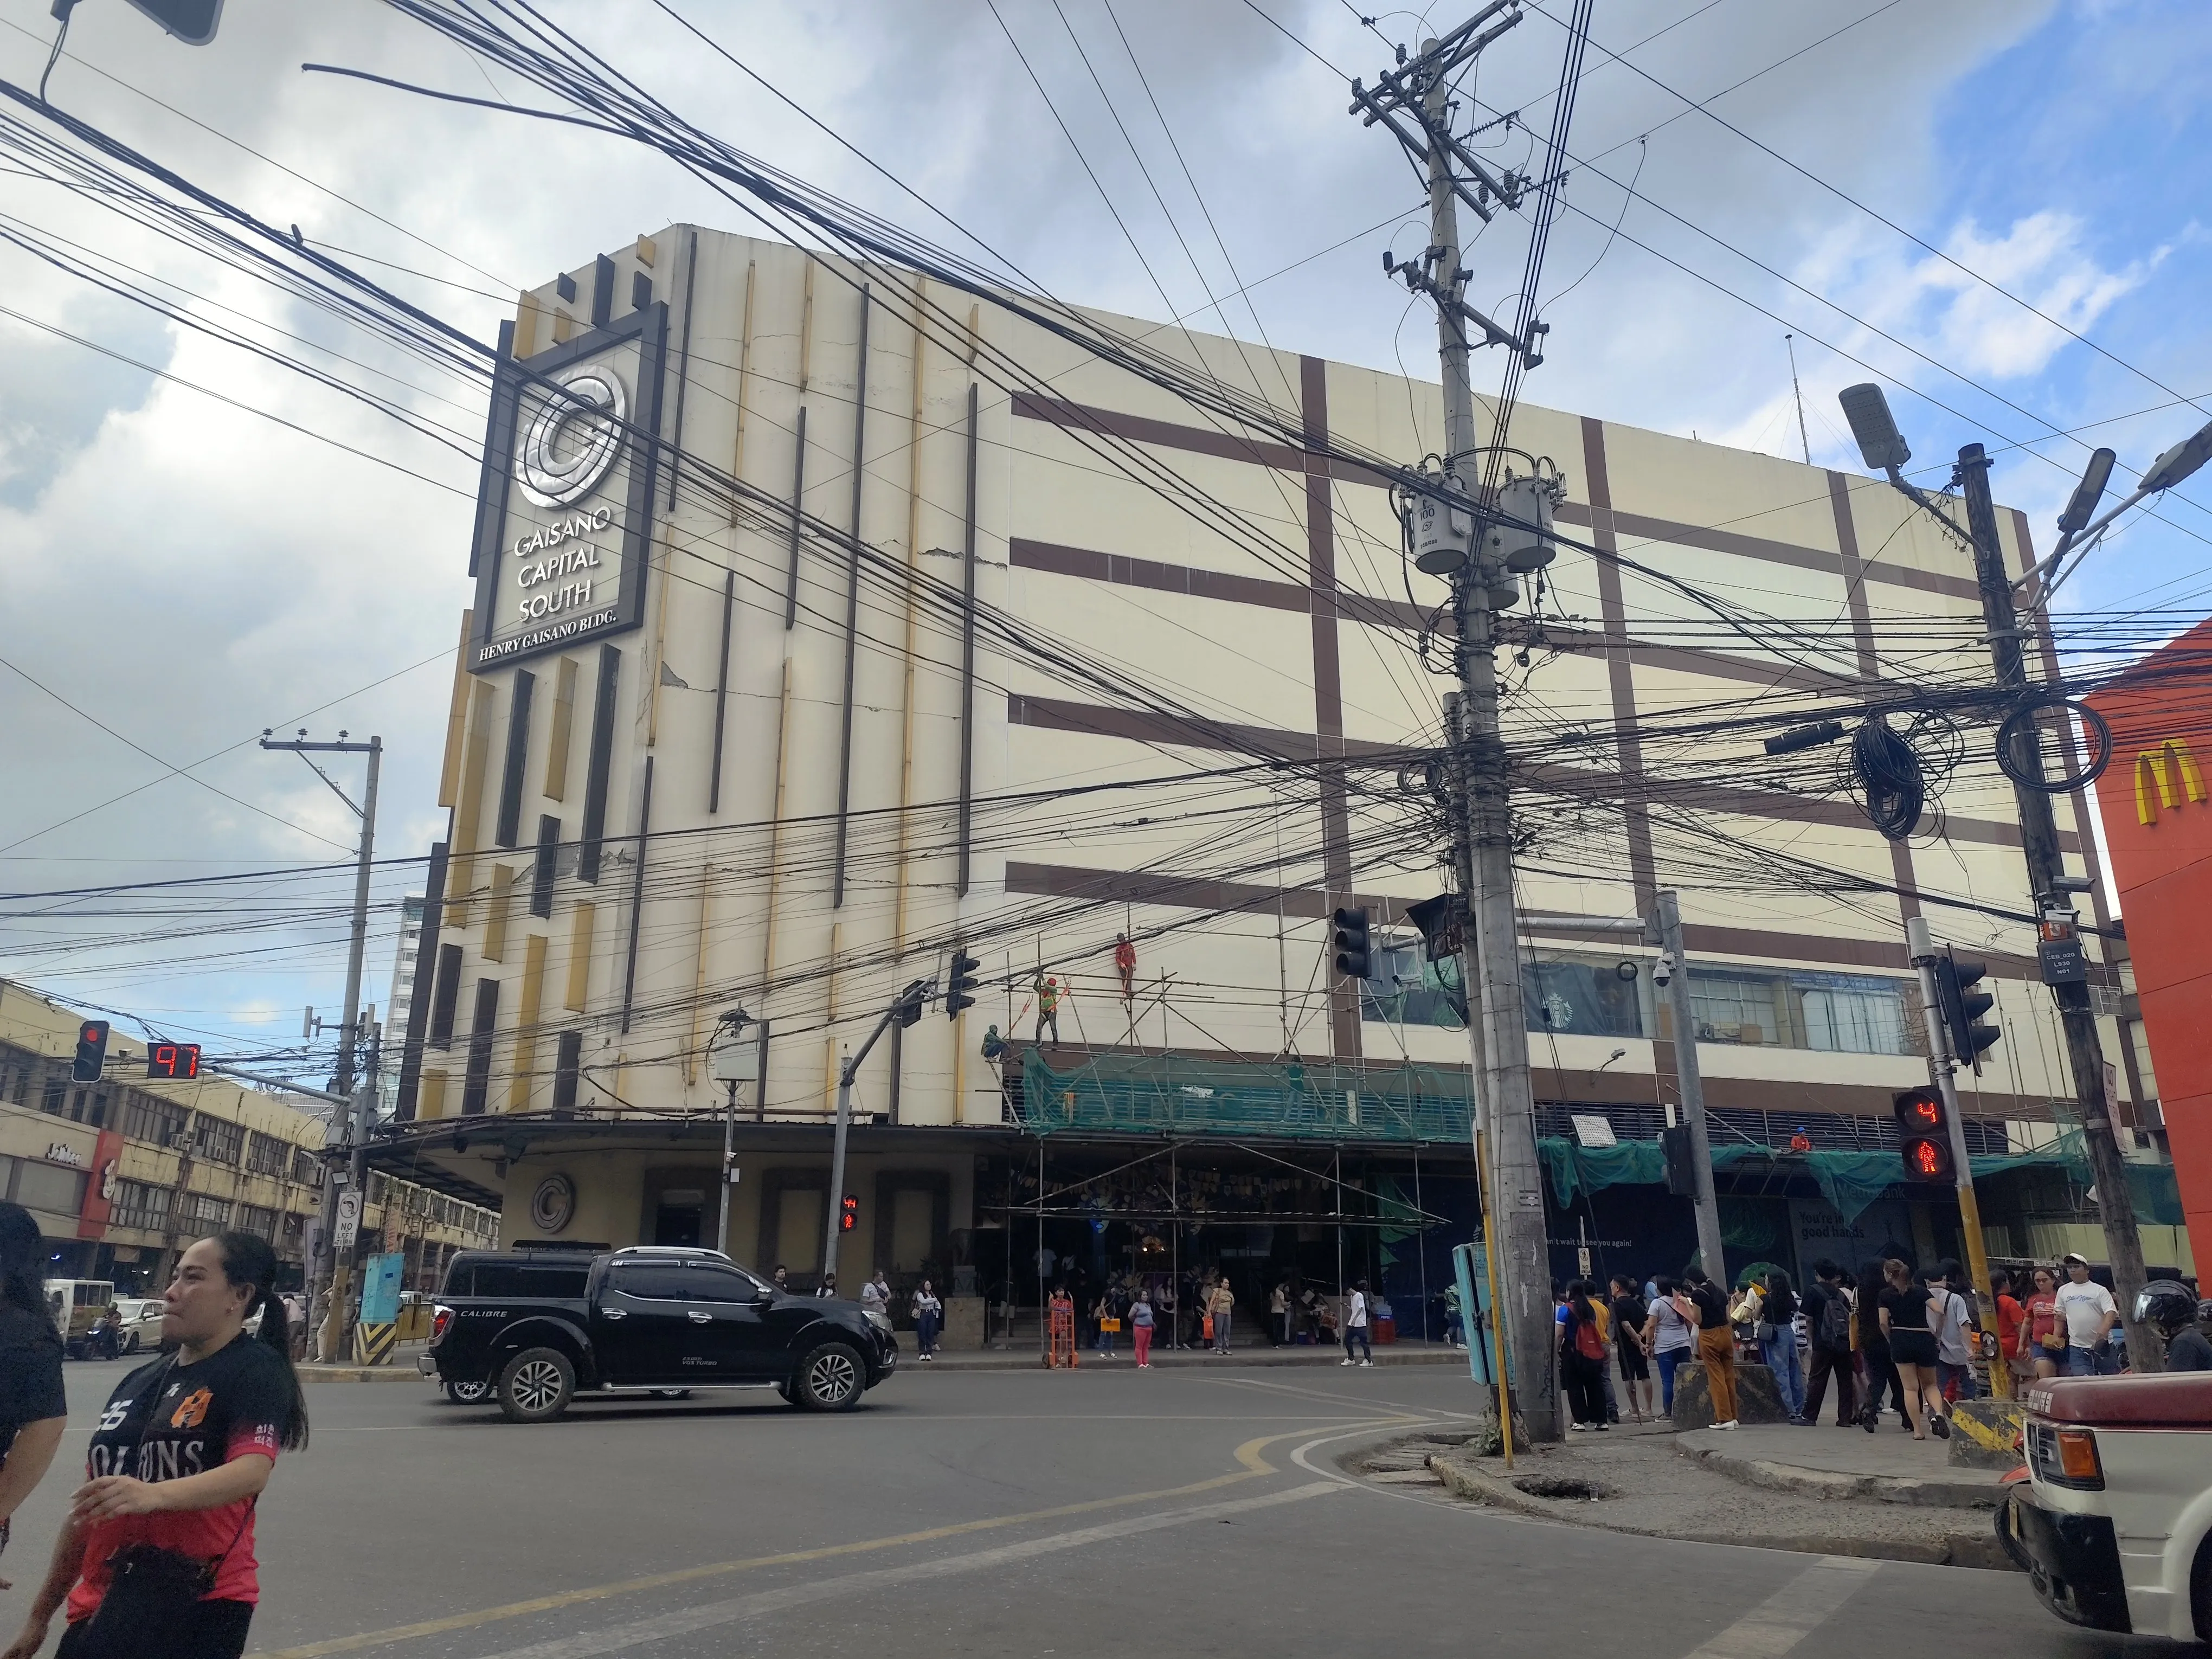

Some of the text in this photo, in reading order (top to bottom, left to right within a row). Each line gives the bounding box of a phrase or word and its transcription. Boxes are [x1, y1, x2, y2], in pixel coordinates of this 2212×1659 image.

[1420, 508, 1435, 520] 100
[515, 506, 610, 557] GAISANO
[518, 544, 599, 588] CAPITAL
[519, 579, 591, 622] SOUTH
[479, 609, 617, 661] HENRY GAISANO BLDG.
[2046, 952, 2075, 960] CEB_020
[1918, 1102, 1937, 1123] 4
[1799, 1211, 1832, 1224] You're
[341, 1223, 352, 1231] NO
[1802, 1225, 1864, 1240] good hands
[1612, 1239, 1632, 1248] again!
